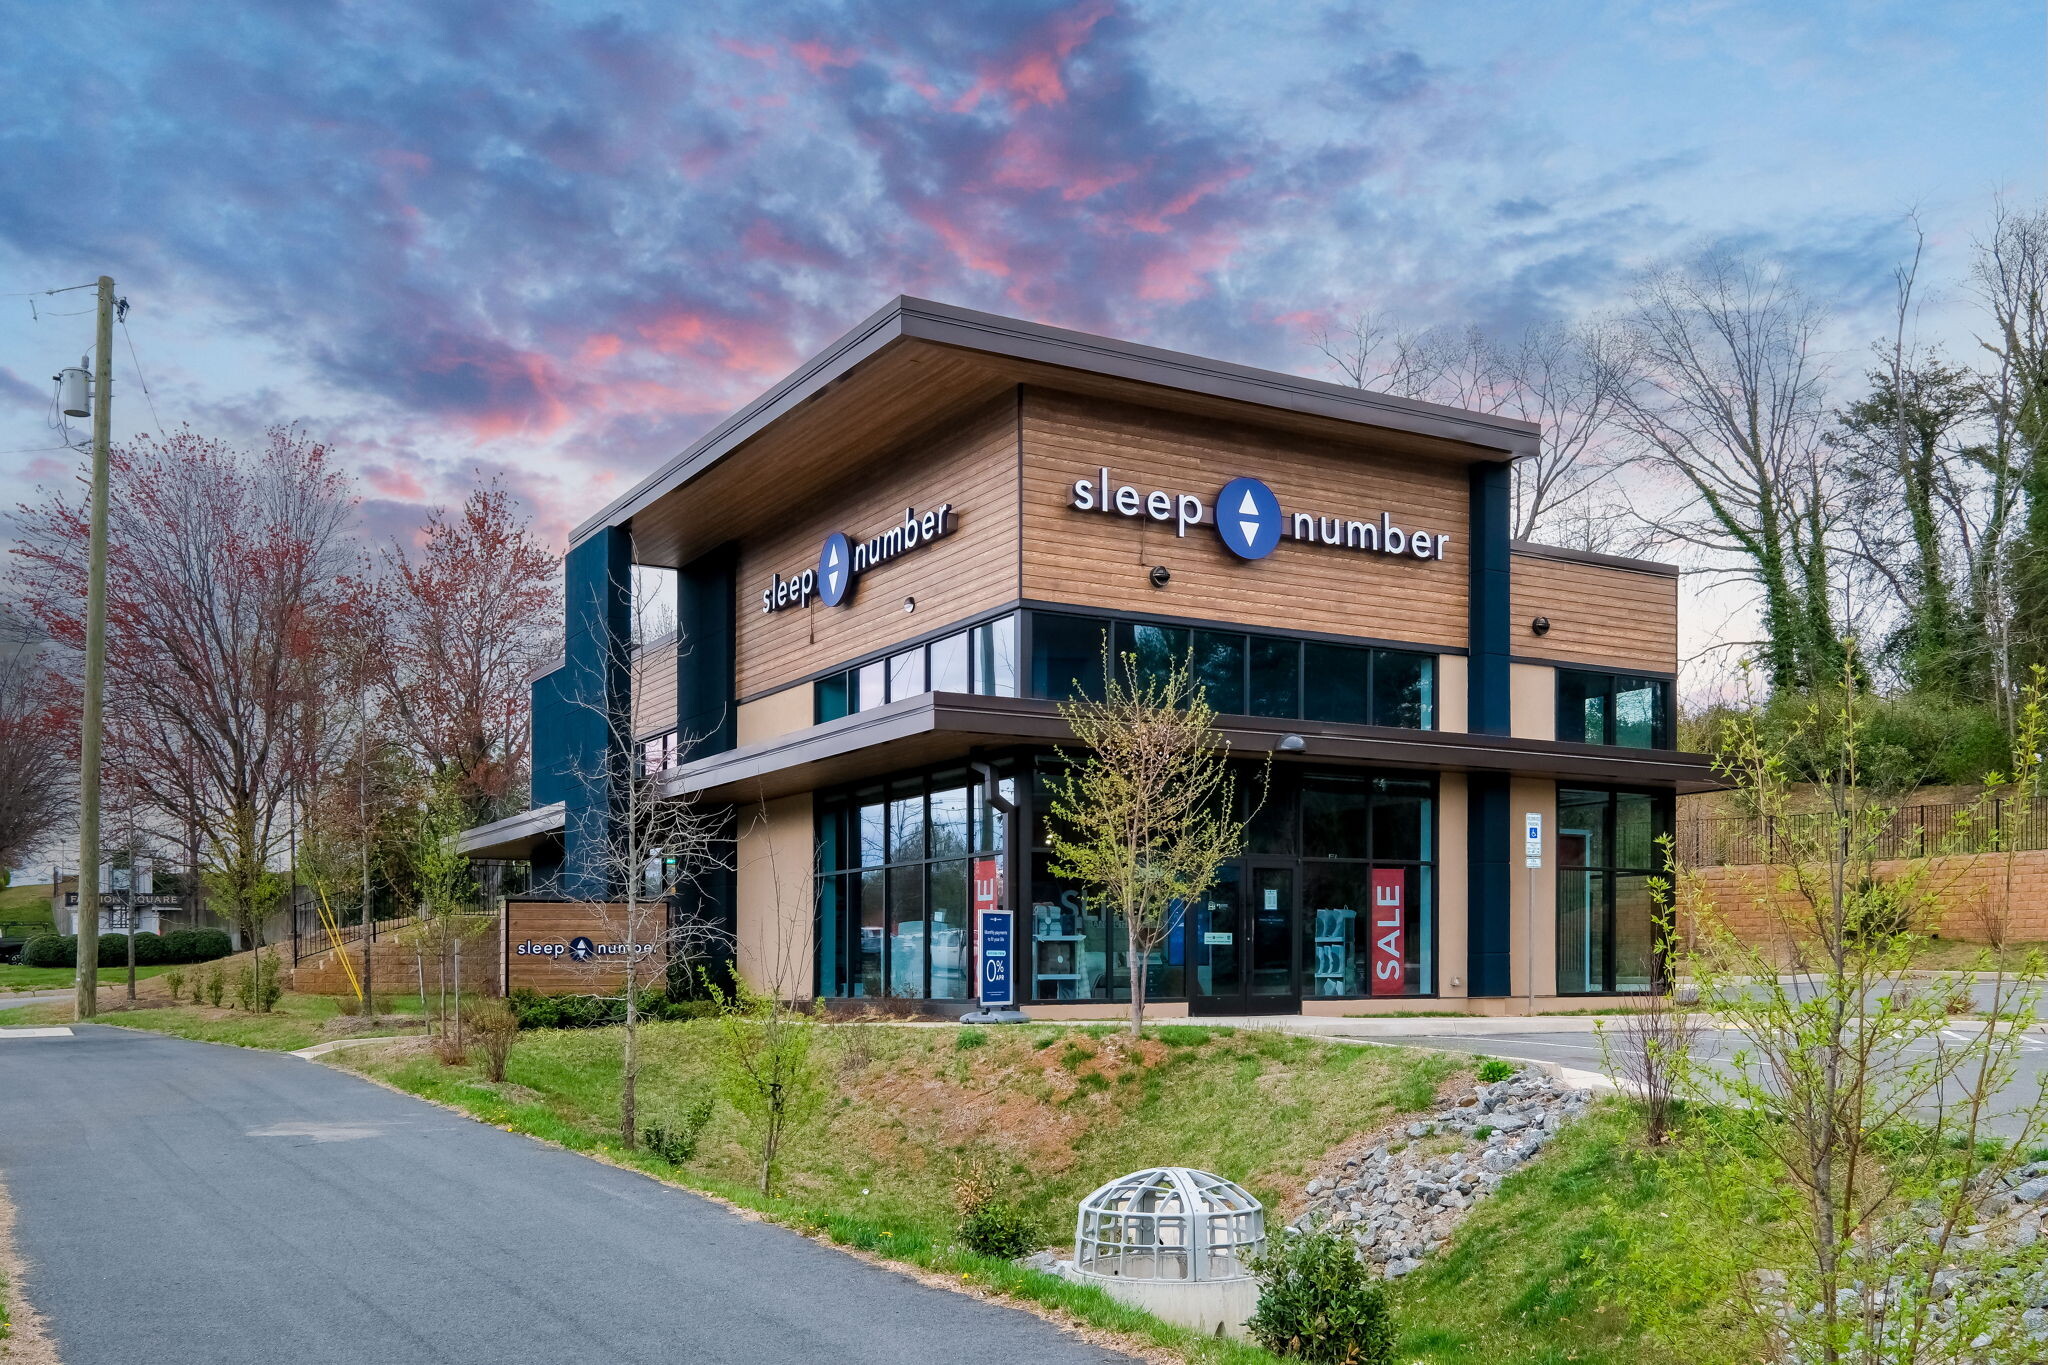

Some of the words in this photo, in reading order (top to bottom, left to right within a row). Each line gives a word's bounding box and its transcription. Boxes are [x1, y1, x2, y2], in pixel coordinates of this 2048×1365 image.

[762, 568, 816, 613] sleep
[854, 503, 952, 572] number
[1072, 467, 1203, 538] sleep
[1291, 512, 1450, 560] number
[70, 895, 120, 903] FION
[1376, 886, 1401, 980] SALE
[517, 939, 565, 959] sleep
